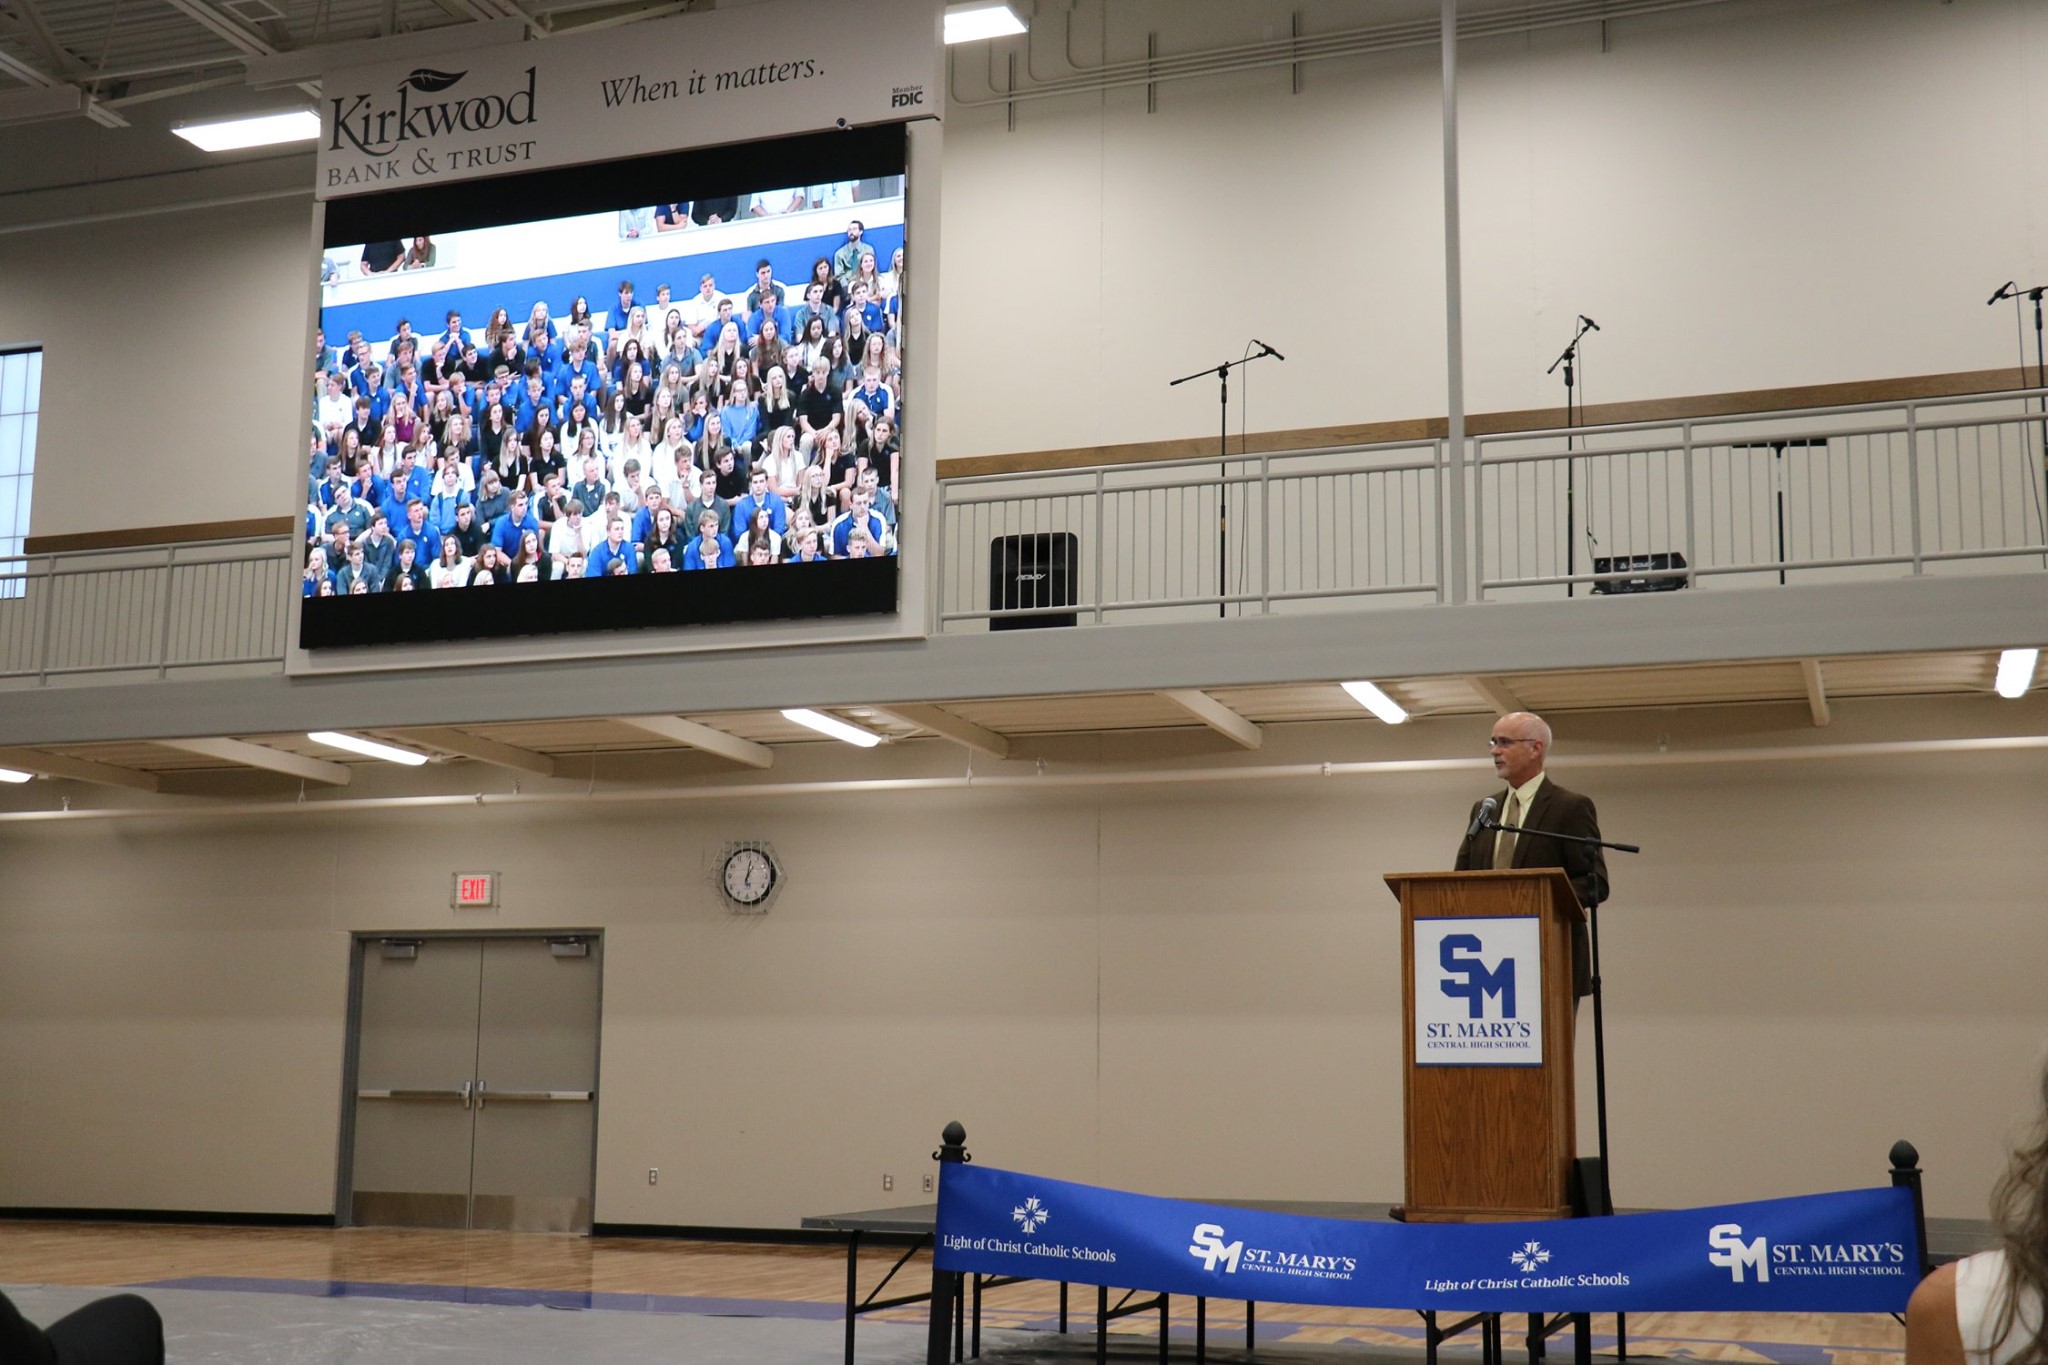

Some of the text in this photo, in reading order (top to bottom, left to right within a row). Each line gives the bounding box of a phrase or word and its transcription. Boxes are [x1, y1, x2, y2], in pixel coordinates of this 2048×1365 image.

[601, 58, 825, 108] When it matters.
[892, 85, 923, 94] Member
[892, 91, 923, 108] FDIC
[329, 66, 538, 157] Kirkwood
[327, 141, 537, 187] BANK & TRUST
[461, 878, 487, 900] EXIT
[1439, 933, 1517, 1019] SM
[1427, 1021, 1531, 1038] ST. MARY'S
[1427, 1041, 1531, 1049] CENTRAL HIGH SCHOOL
[943, 1235, 1116, 1263] Light of Christ Catholic Schools
[1189, 1223, 1244, 1274] SM
[1244, 1248, 1357, 1271] ST. MARY'S
[1708, 1223, 1770, 1283] SM
[1772, 1242, 1904, 1263] ST. MARY'S
[1241, 1263, 1352, 1280] CENTRAL HIGH SCHOOL
[1424, 1272, 1630, 1292] Light of Christ Catholic Schools
[1774, 1266, 1905, 1276] CENTRAL HIGH SCHOOL
